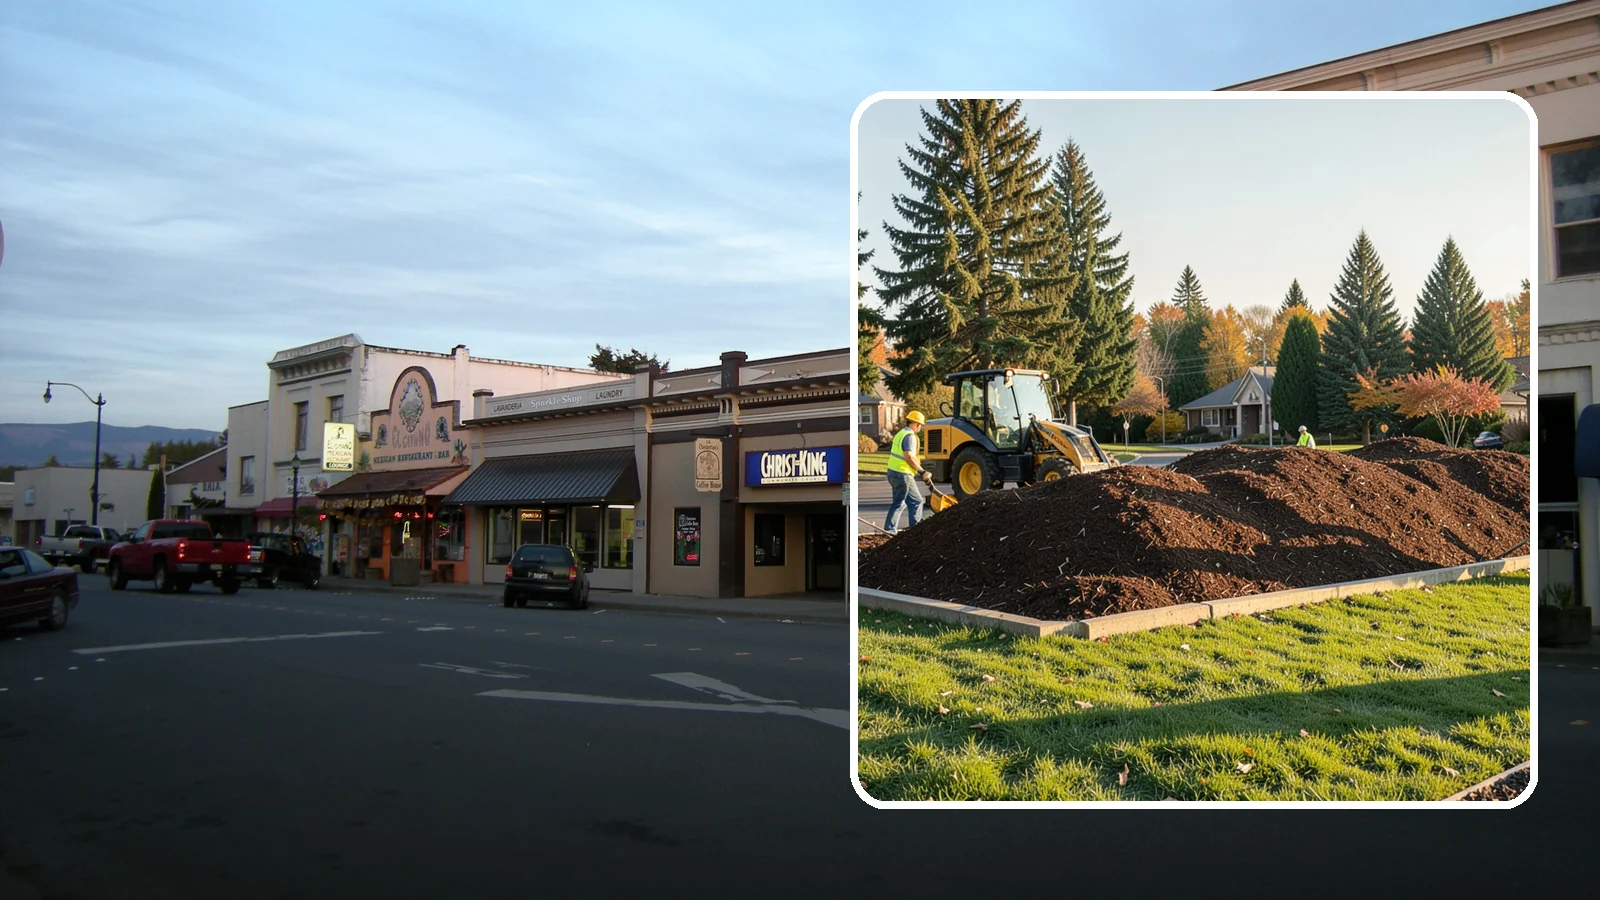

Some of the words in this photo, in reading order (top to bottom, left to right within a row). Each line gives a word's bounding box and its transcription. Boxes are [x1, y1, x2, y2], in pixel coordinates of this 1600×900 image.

[493, 402, 523, 413] LAVANDERIA
[530, 397, 561, 410] Sparkle
[562, 393, 583, 406] Shop
[595, 388, 624, 400] LAUNDRY
[373, 454, 396, 464] MEXICAN
[397, 450, 434, 462] RESTAURANT
[438, 450, 450, 459] BAR
[760, 451, 797, 478] CHRIST
[799, 449, 827, 476] KING
[696, 480, 709, 488] Coffee
[709, 480, 722, 489] House
